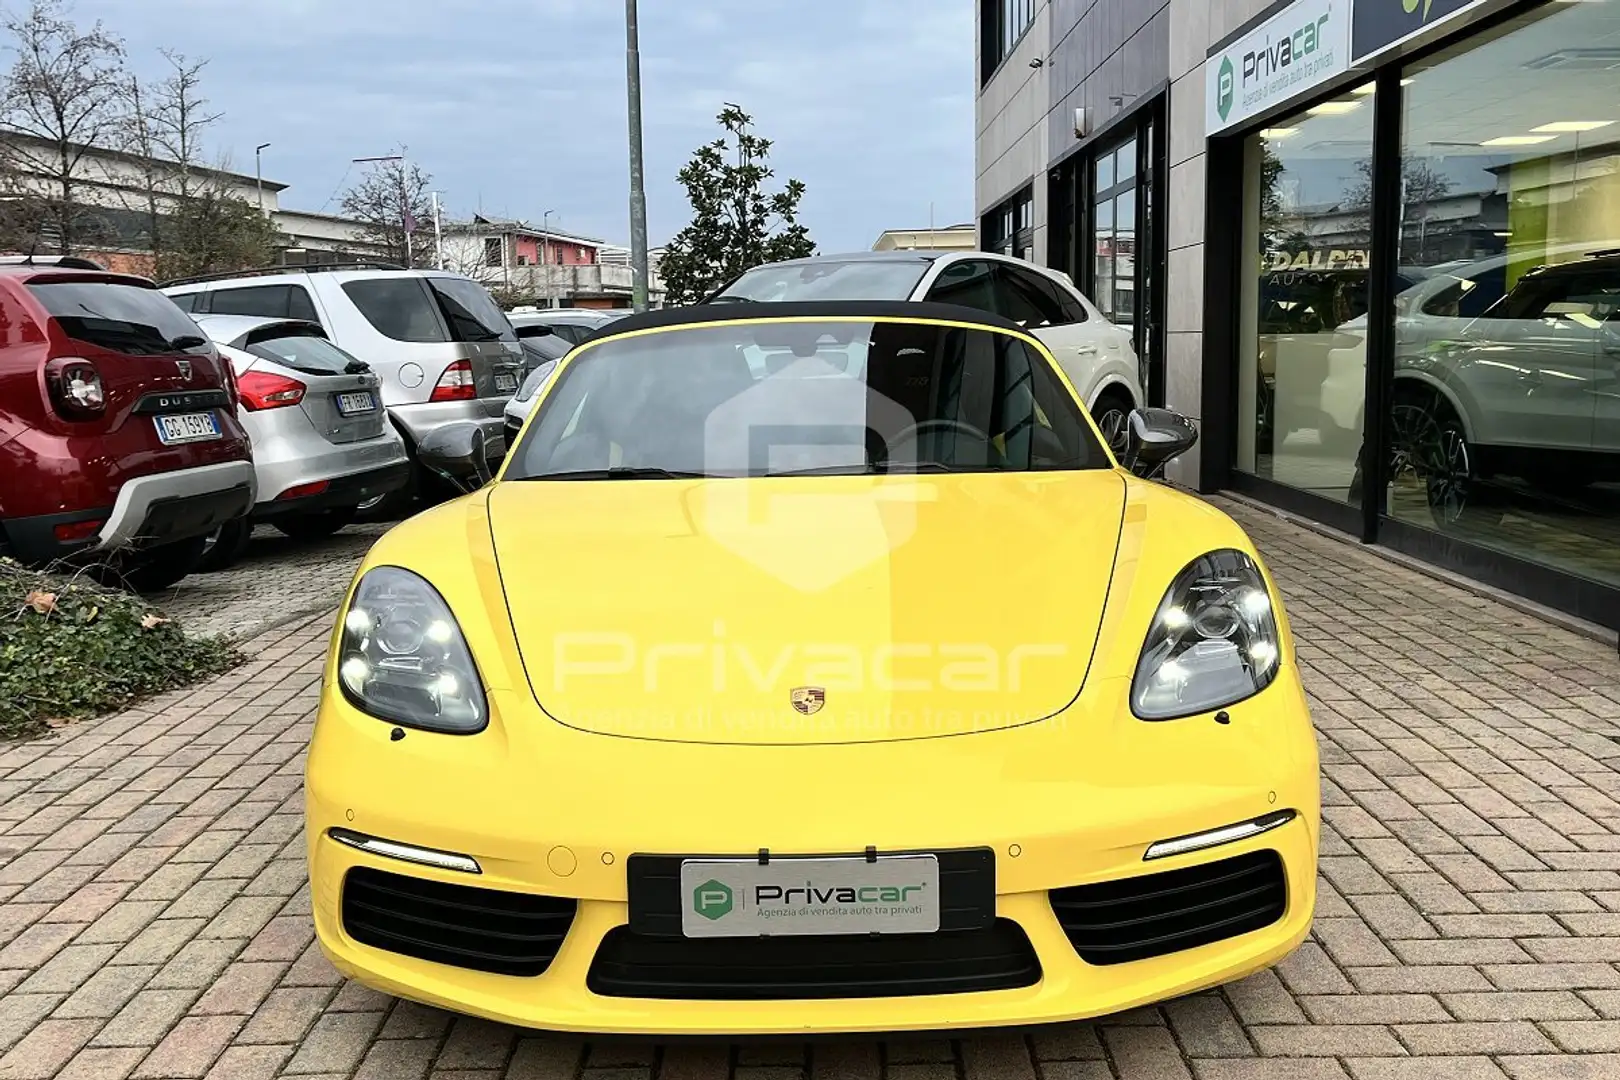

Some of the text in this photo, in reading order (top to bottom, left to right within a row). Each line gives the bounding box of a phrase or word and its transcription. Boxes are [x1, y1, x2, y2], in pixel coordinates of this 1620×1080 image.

[1242, 13, 1328, 88] Privacar
[756, 880, 922, 905] Privacar
[757, 905, 923, 919] Agenzia di vendita auto tra privati
